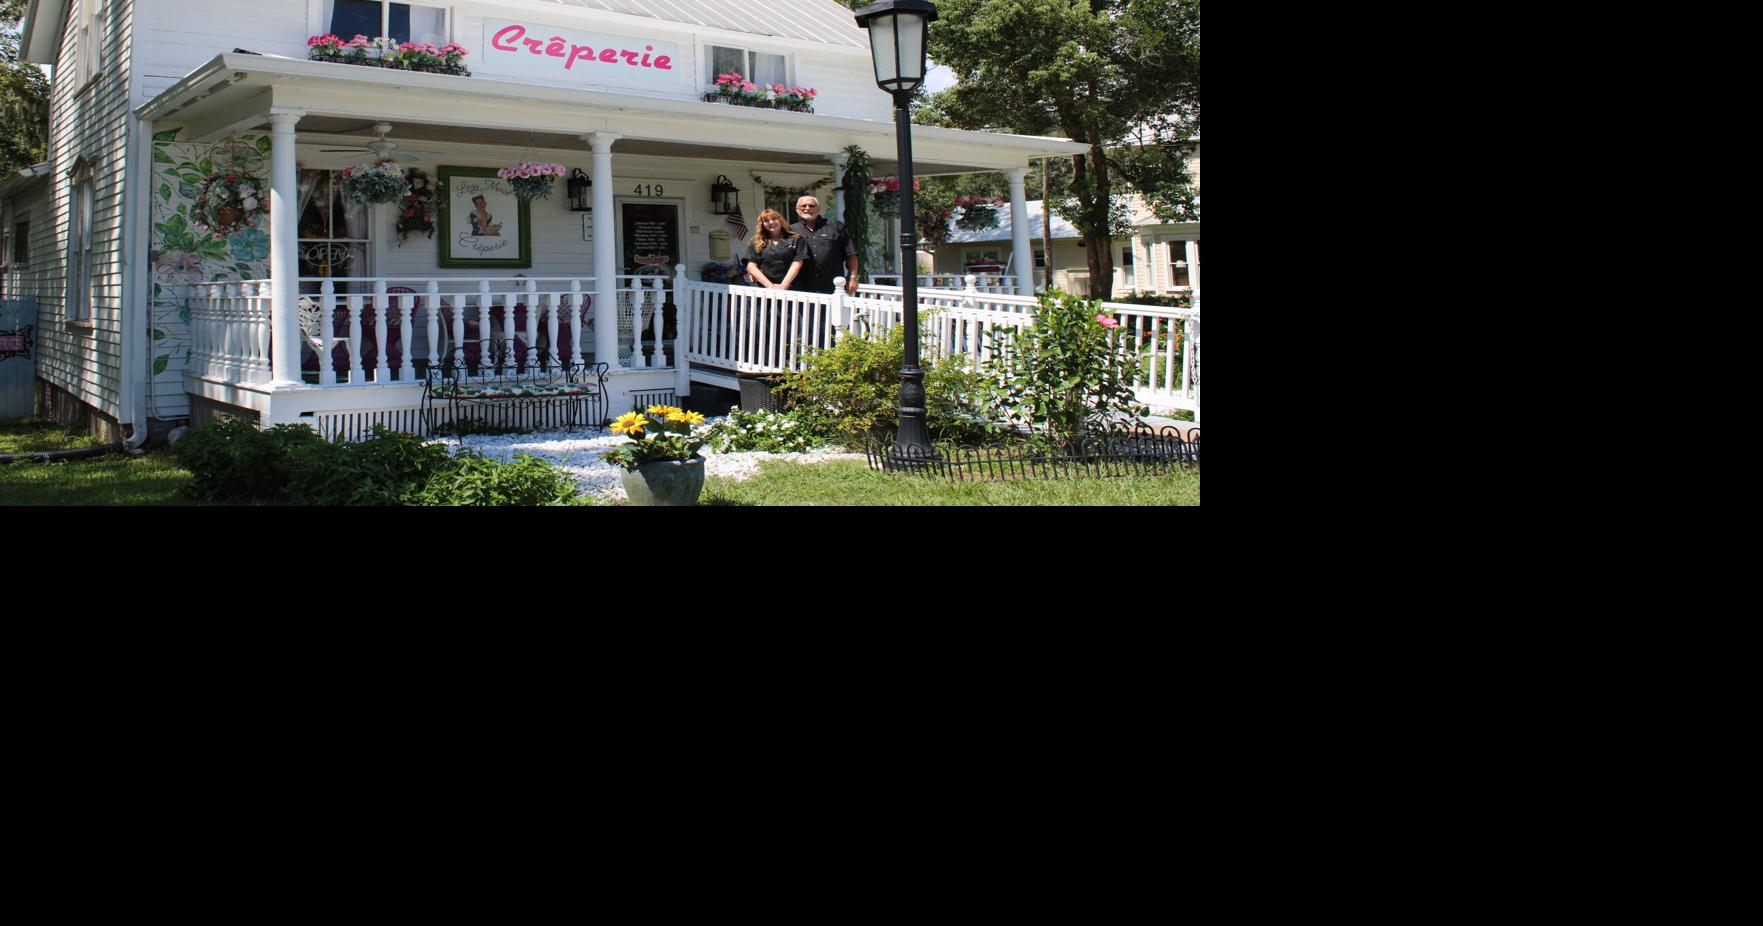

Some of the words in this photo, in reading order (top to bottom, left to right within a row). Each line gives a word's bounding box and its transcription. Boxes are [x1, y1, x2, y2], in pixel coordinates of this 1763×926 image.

[491, 24, 672, 70] Crêperie
[634, 184, 664, 197] 419
[307, 247, 347, 260] OPEN
